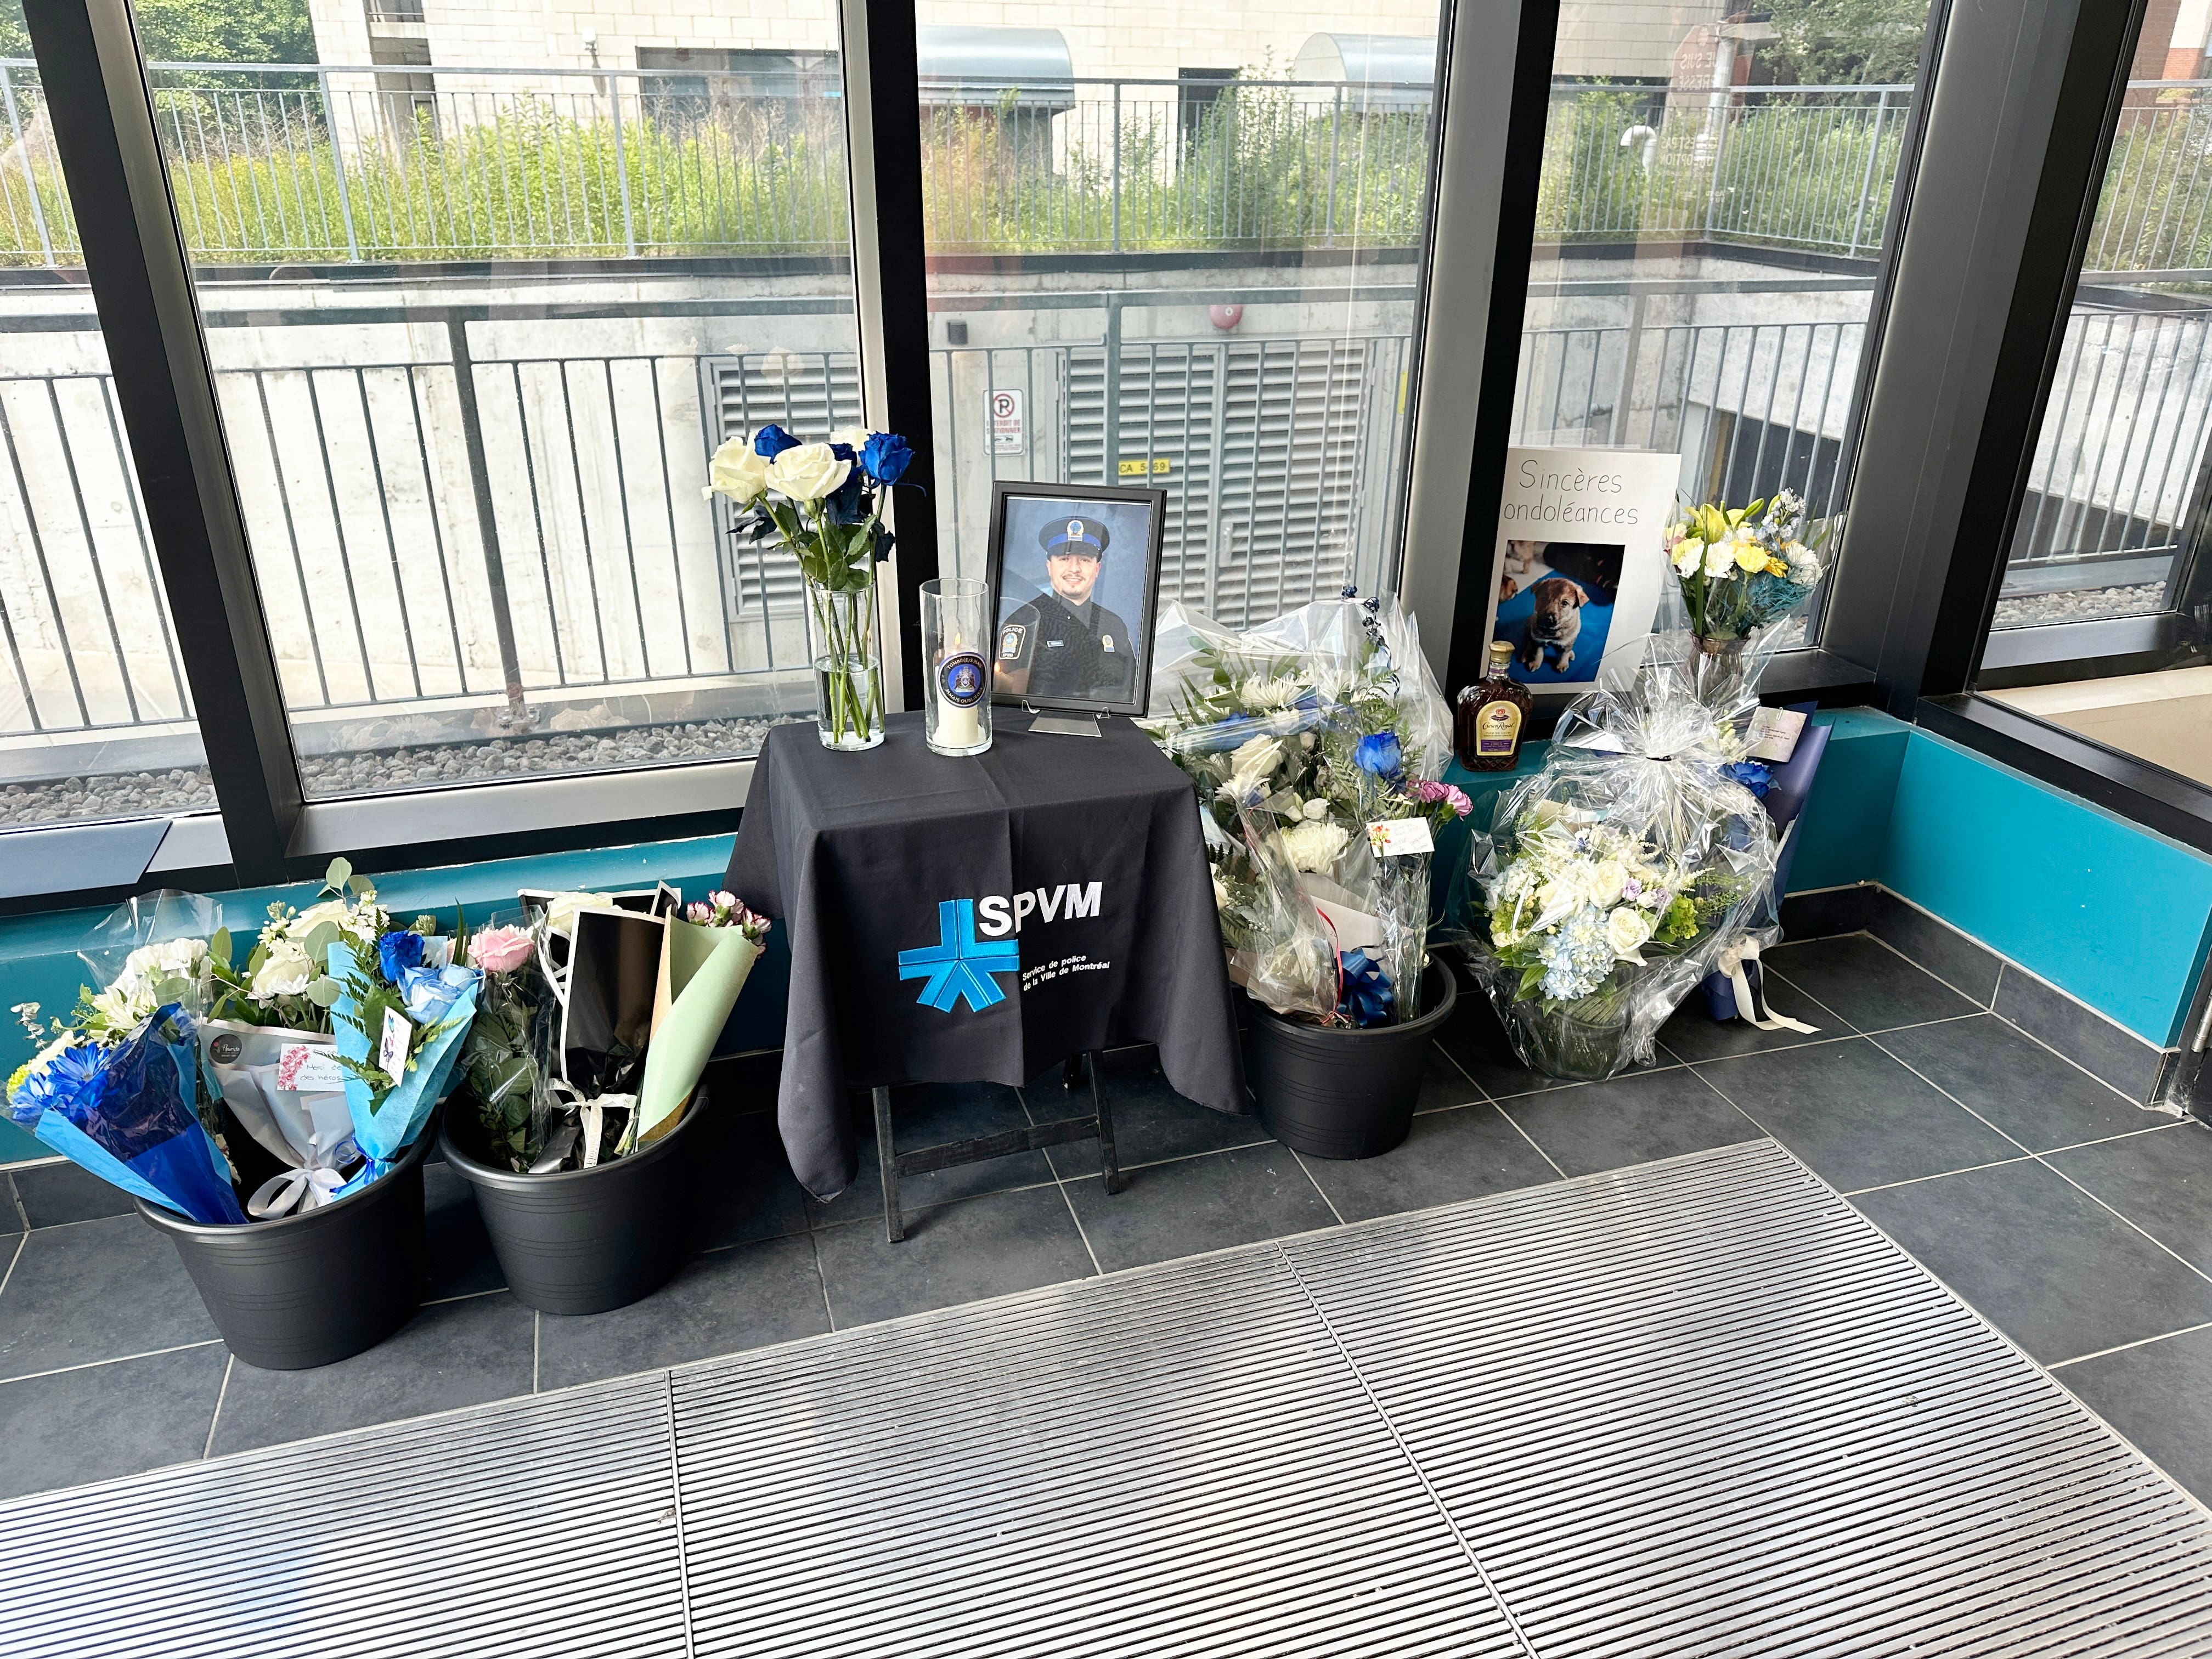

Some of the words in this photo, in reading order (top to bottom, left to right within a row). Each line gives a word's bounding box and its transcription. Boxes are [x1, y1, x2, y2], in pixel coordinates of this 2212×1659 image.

[1140, 462, 1165, 471] 569
[1519, 460, 1622, 493] Sincères
[1504, 494, 1638, 524] ondoléances
[944, 689, 960, 702] JAMAIS
[979, 882, 1103, 936] SPVM
[1023, 965, 1046, 981] Service
[1048, 961, 1058, 969] de
[1061, 955, 1087, 967] police
[1023, 983, 1031, 991] de
[1040, 970, 1056, 981] Ville
[1059, 967, 1069, 975] de
[1072, 961, 1110, 972] Montréal
